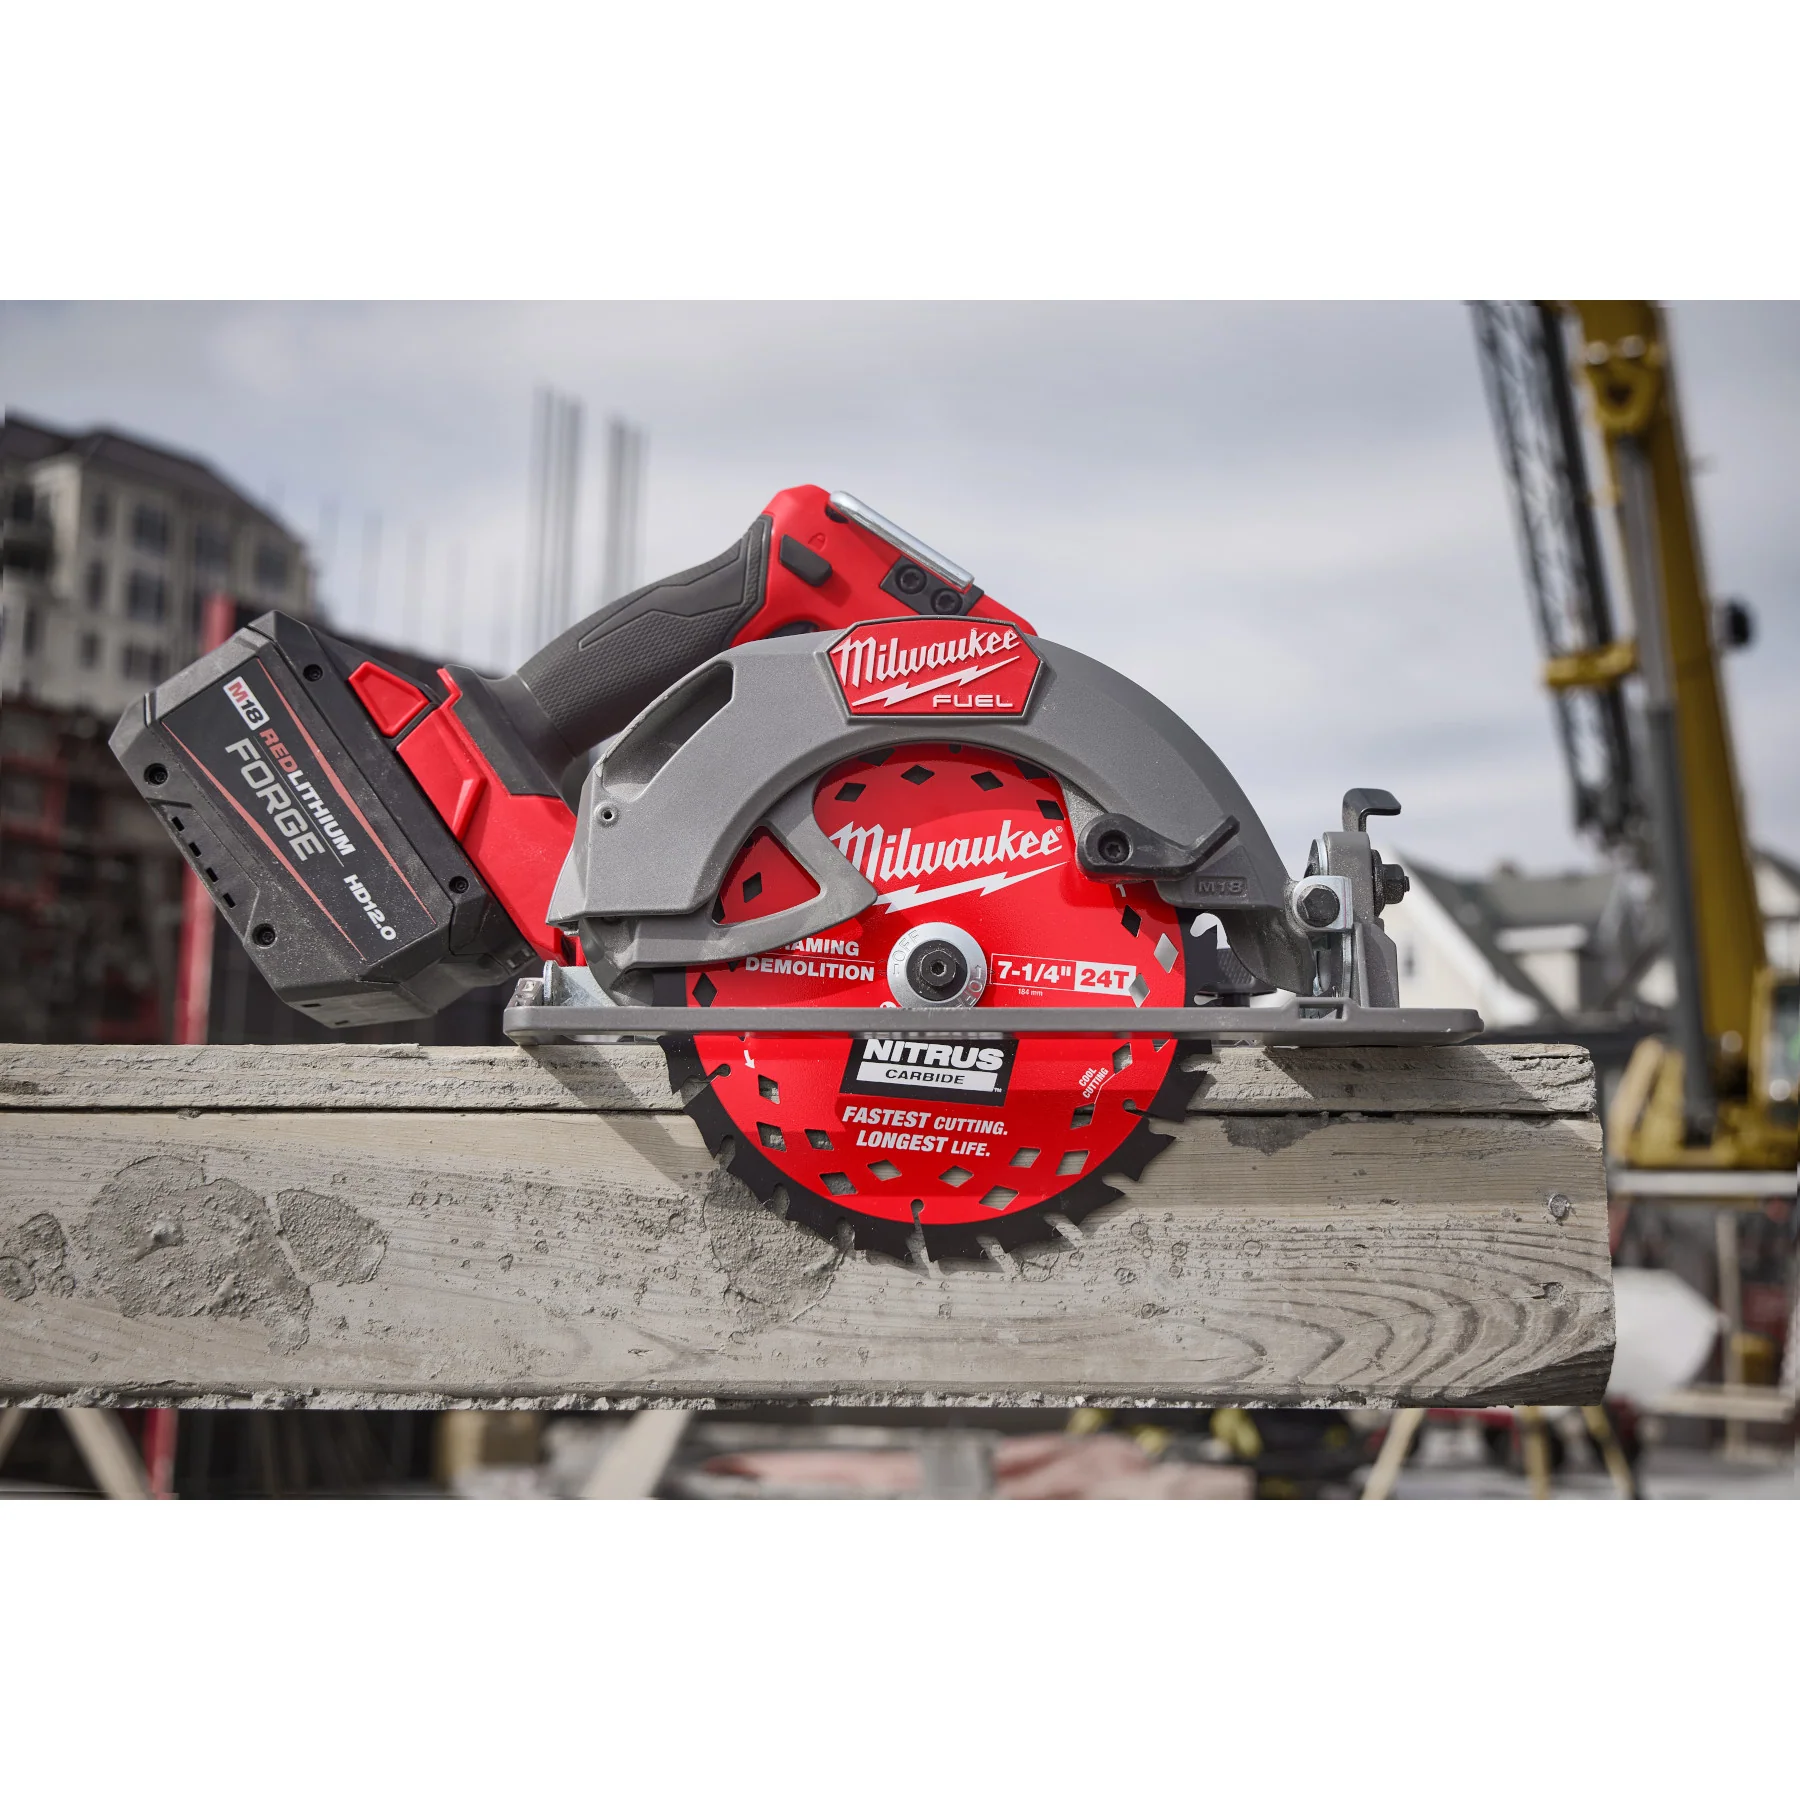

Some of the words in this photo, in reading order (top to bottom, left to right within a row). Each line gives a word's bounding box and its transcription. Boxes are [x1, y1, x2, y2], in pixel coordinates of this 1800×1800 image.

[830, 628, 1020, 688] Milwaukee
[932, 695, 1014, 709] FUEL
[227, 680, 265, 725] M18
[259, 728, 356, 856] REDLITHIUM
[225, 737, 325, 862] FORGE
[1198, 881, 1243, 894] M18
[343, 874, 397, 941] HD12.0
[784, 938, 859, 957] AMING
[892, 929, 919, 962] OFF
[745, 957, 875, 982] DEMOLITION
[998, 961, 1072, 984] 7-1/4"
[1080, 968, 1130, 989] 24T
[1018, 988, 1030, 996] 184
[1031, 989, 1043, 997] mm
[863, 1039, 1005, 1071] NITRUS
[885, 1069, 966, 1085] CARBIDE
[1078, 1067, 1097, 1087] COOL
[1082, 1067, 1109, 1099] CUTTING
[842, 1105, 932, 1129] FASTEST
[933, 1116, 1009, 1136] CUTTING.
[856, 1129, 949, 1153] LONGEST
[950, 1140, 991, 1157] LIFE.
